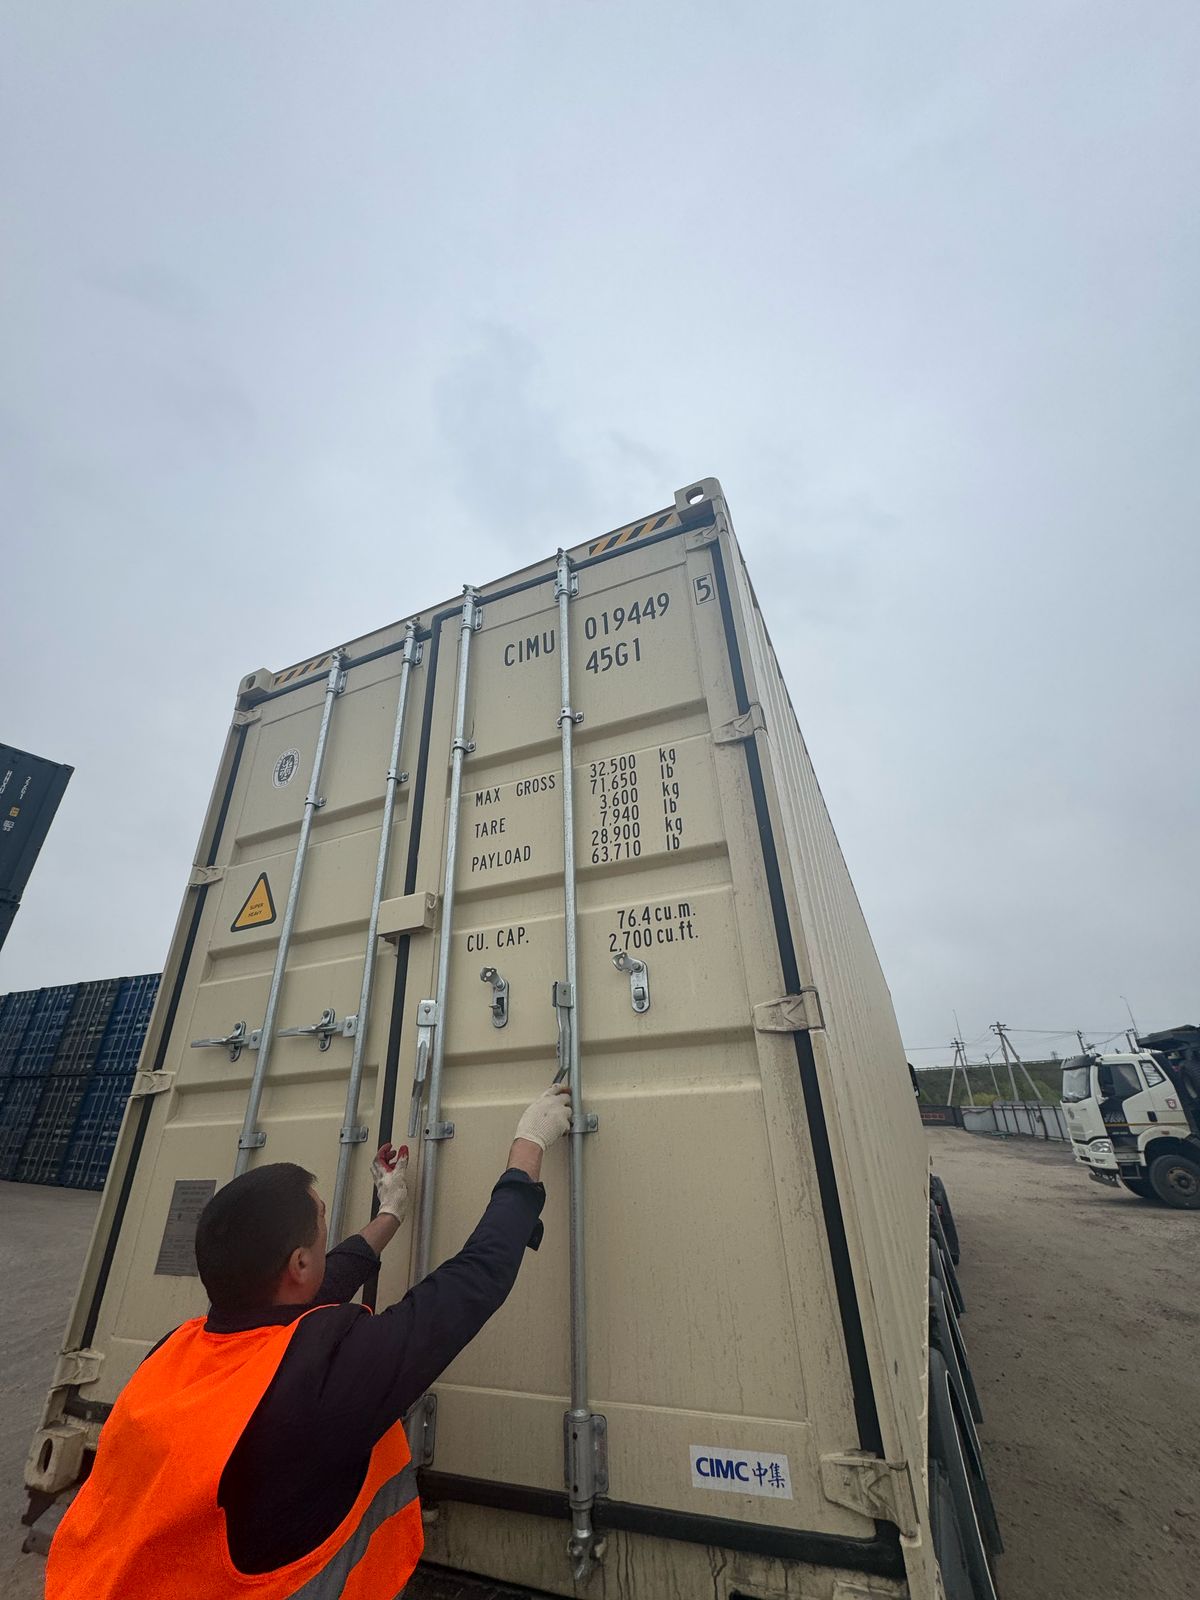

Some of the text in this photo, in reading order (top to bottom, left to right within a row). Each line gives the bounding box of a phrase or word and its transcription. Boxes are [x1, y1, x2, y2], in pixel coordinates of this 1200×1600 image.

[503, 577, 712, 667] CIMU 019449 5
[585, 638, 641, 674] 45G1
[475, 788, 501, 807] MAX
[515, 774, 556, 797] GROSS
[658, 747, 677, 766] kg
[660, 763, 674, 780] lb
[474, 817, 506, 839] TARE
[662, 781, 680, 800] kg
[663, 797, 678, 815] lb
[471, 845, 531, 872] PAYLOAD
[664, 816, 683, 836] kg
[666, 832, 680, 851] lb
[466, 933, 489, 952] CU.
[496, 926, 529, 948] CAP.
[616, 905, 651, 930] 76.4
[695, 1456, 786, 1489] CIMC 中集
